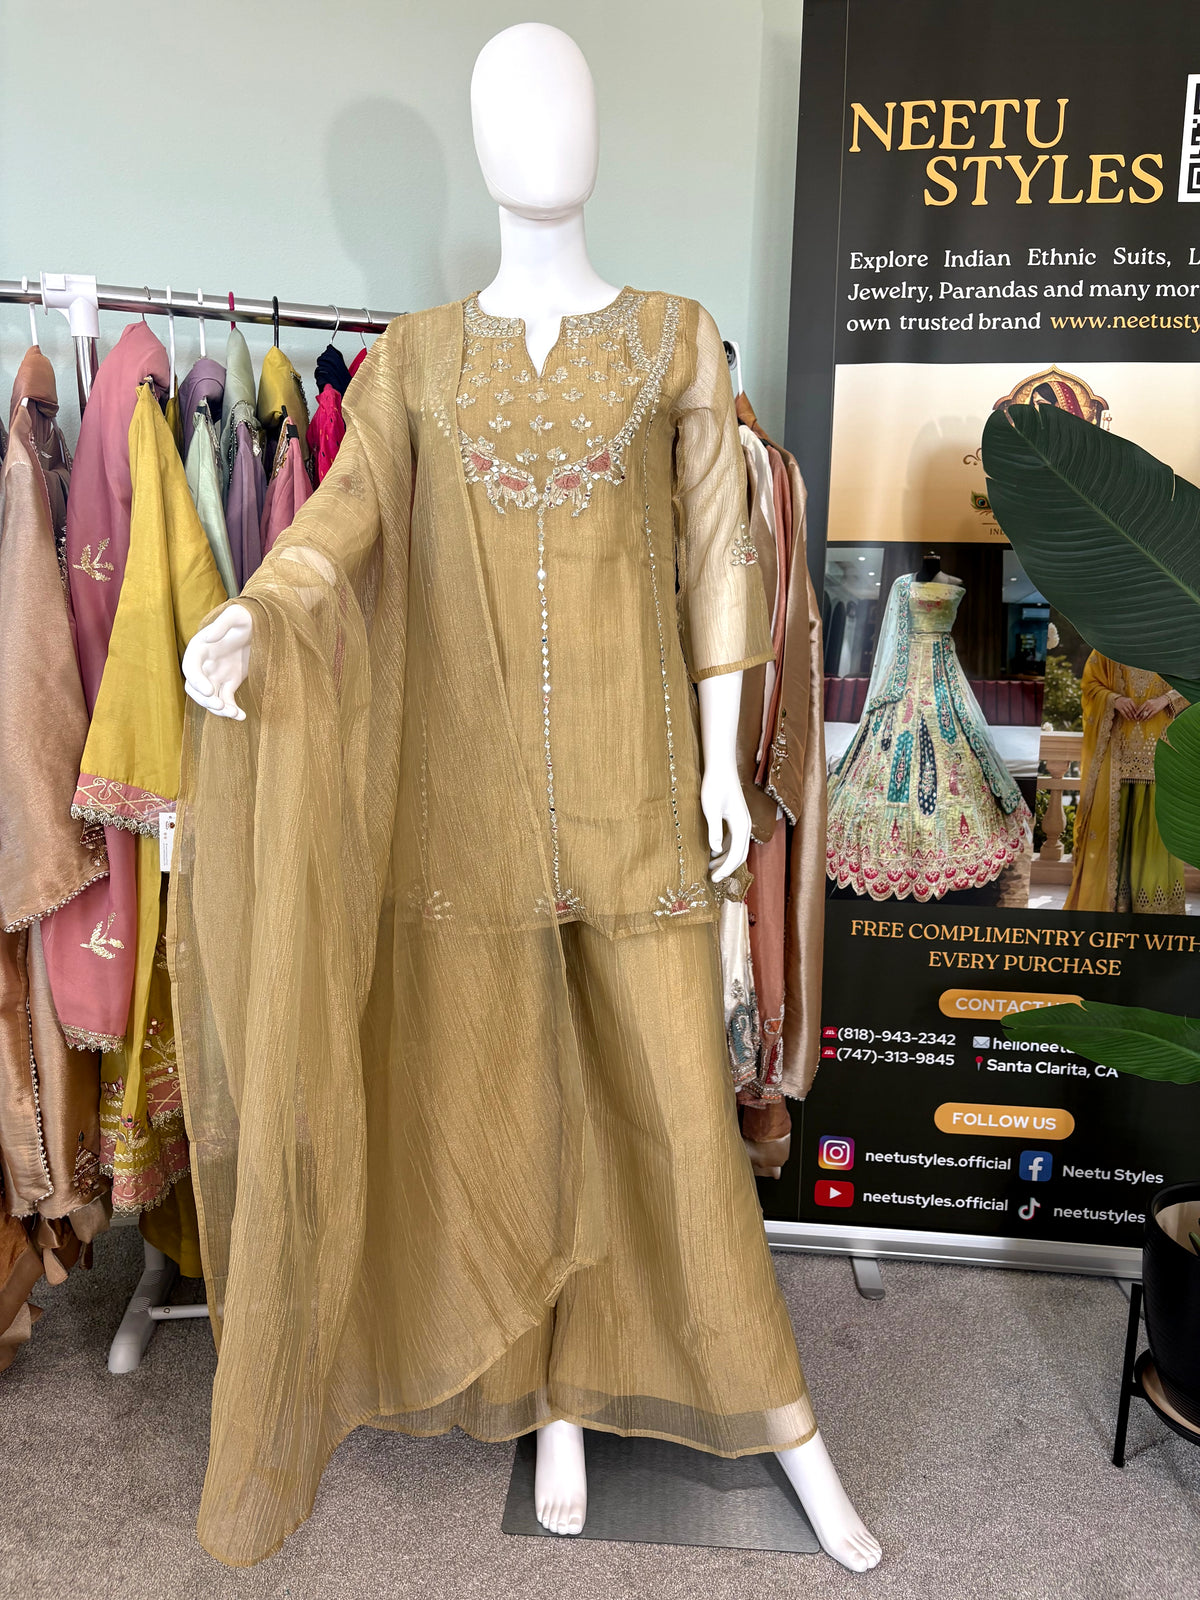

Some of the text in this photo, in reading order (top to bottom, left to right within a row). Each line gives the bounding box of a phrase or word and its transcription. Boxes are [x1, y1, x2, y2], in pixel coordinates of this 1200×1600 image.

[849, 99, 1069, 152] NEETU
[924, 154, 1164, 206] STYLES
[849, 250, 929, 273] Explore
[943, 249, 1012, 268] Indian
[1027, 247, 1097, 266] Ethnic
[1113, 246, 1172, 268] Suits,
[847, 281, 934, 303] Jewelry,
[938, 280, 1038, 300] Parandas
[1043, 279, 1084, 298] and
[1088, 283, 1151, 302] many
[846, 317, 891, 332] own
[899, 312, 974, 331] trusted
[978, 311, 1041, 330] brand
[851, 919, 904, 939] FREE
[908, 923, 1085, 947] COMPLIMENTRY
[1089, 931, 1140, 950] GIFT
[928, 951, 1122, 976] EVERY PURCHASE
[837, 1027, 956, 1047] (818)-943-2342
[836, 1047, 955, 1066] (747)-313-9845
[986, 1058, 1119, 1079] Santa Clarita, CA
[952, 1112, 1057, 1131] FOLLOW US
[865, 1151, 1011, 1170] neetustyles.official
[1062, 1165, 1164, 1185] Neetu Styles
[863, 1191, 1008, 1212] neetustyles.official
[1053, 1207, 1146, 1225] neetustyles
